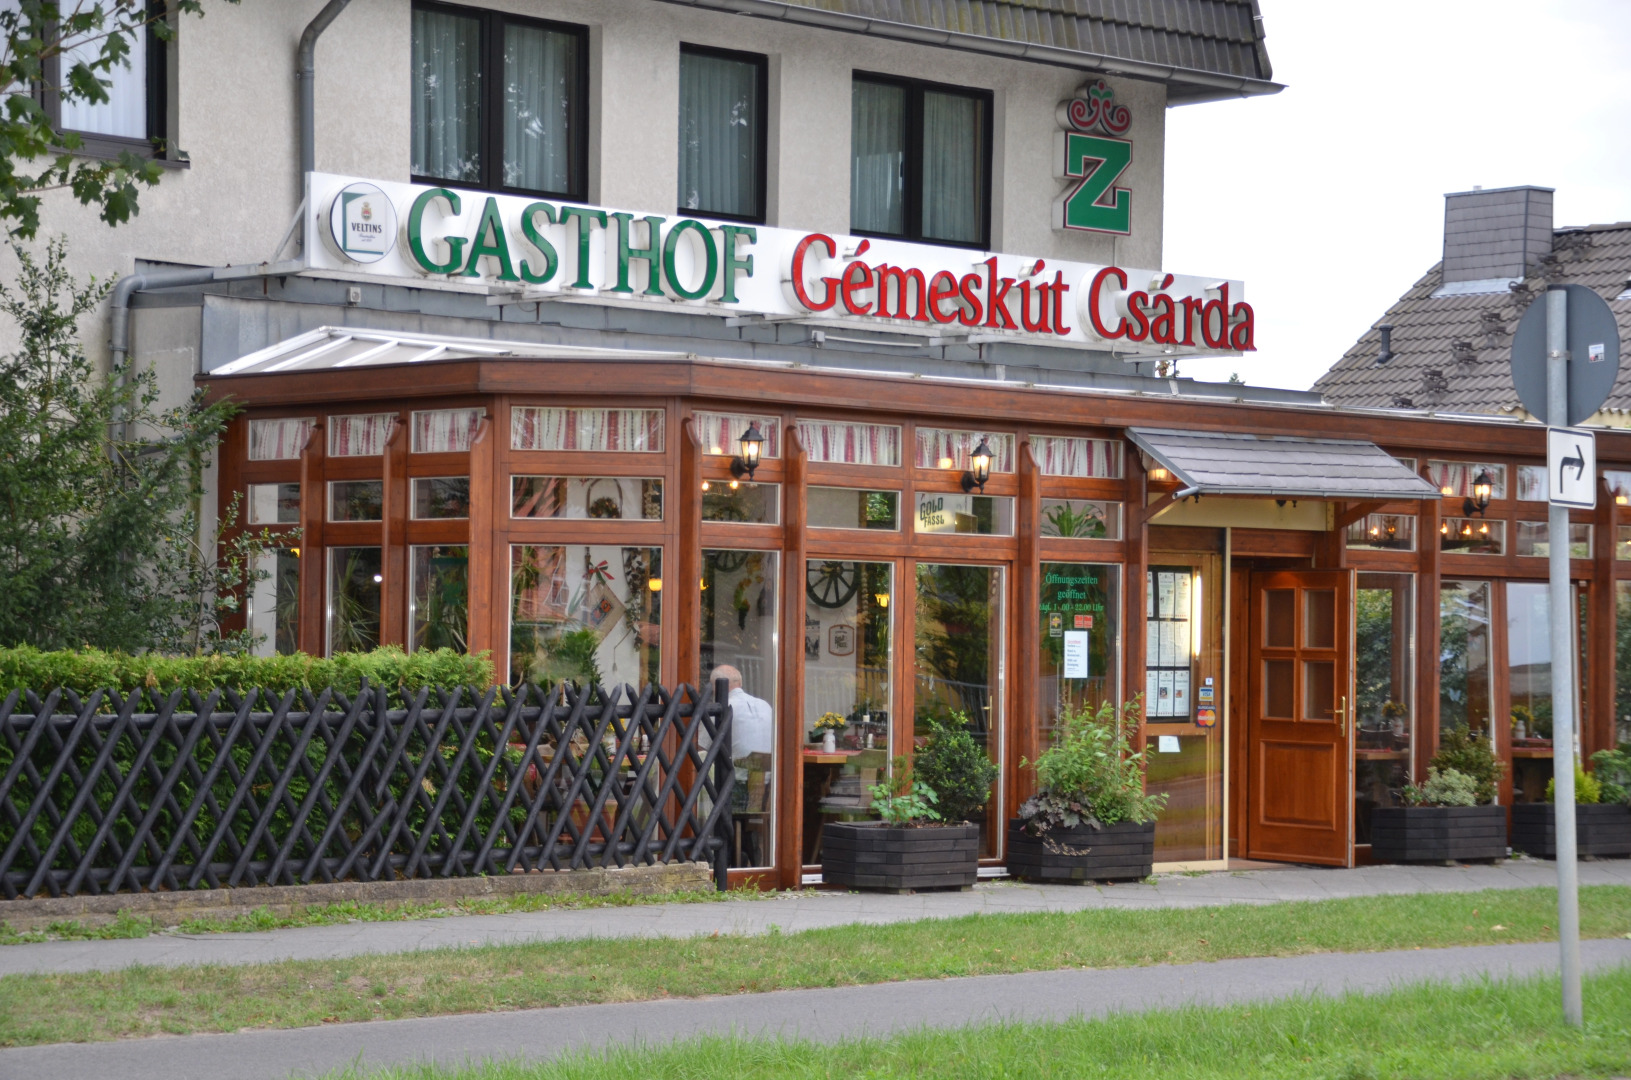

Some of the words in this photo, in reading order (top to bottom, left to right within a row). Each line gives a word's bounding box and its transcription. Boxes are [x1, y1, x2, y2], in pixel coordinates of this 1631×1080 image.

[1064, 131, 1133, 236] Z
[351, 222, 382, 233] VELTINS
[407, 187, 757, 303] GASTHOF
[791, 232, 1071, 336] Gémeskút
[1088, 266, 1257, 352] Csárda
[920, 497, 943, 520] GOLD
[1045, 572, 1098, 587] Öffnungszeiten
[1057, 589, 1086, 600] geöffnet
[1092, 603, 1104, 612] Uhr
